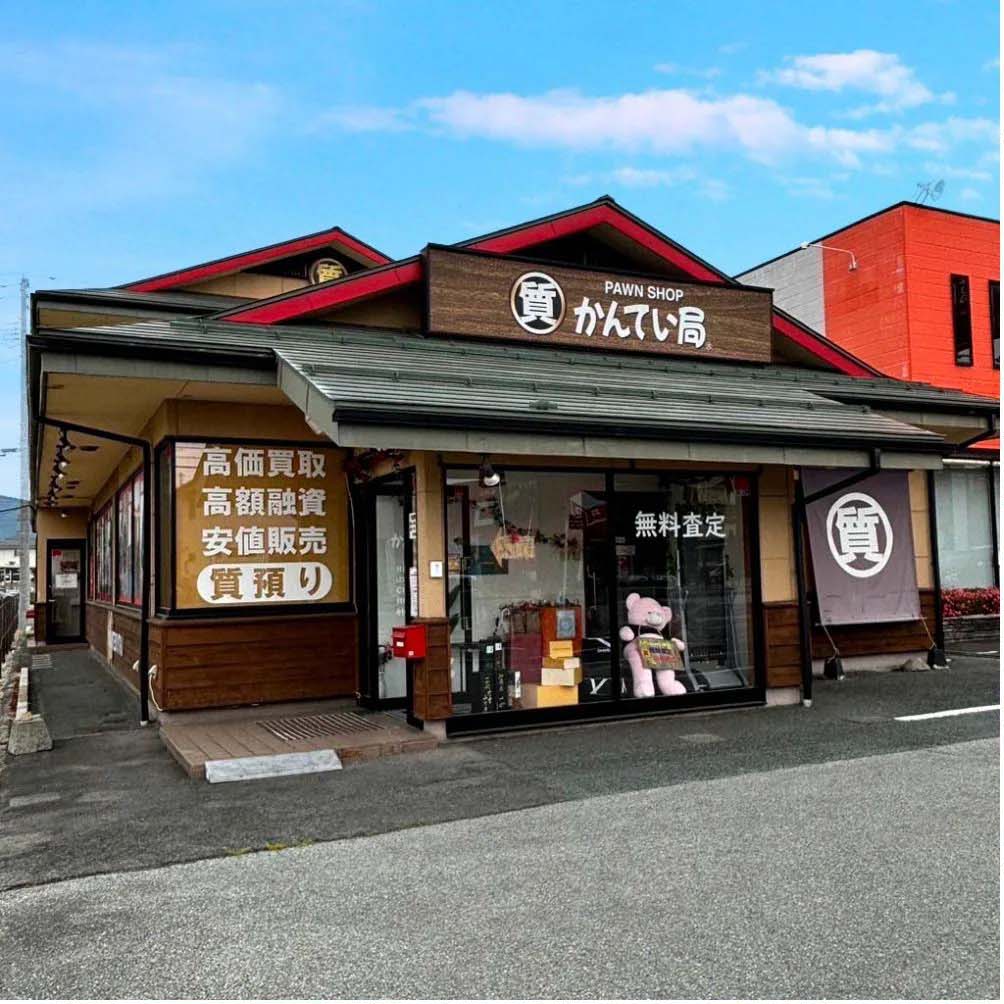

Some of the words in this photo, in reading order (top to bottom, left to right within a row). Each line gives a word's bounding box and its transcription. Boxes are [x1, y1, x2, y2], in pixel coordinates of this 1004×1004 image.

[519, 281, 557, 325] 質
[604, 281, 644, 298] PAWN
[648, 286, 684, 302] SHOP
[574, 296, 706, 348] かんてい局
[202, 448, 326, 478] 高価買取
[202, 487, 326, 517] 高額融資
[634, 511, 726, 538] 無料査定
[836, 506, 884, 564] 質
[202, 527, 327, 556] 安値販売
[209, 566, 322, 600] 質預り
